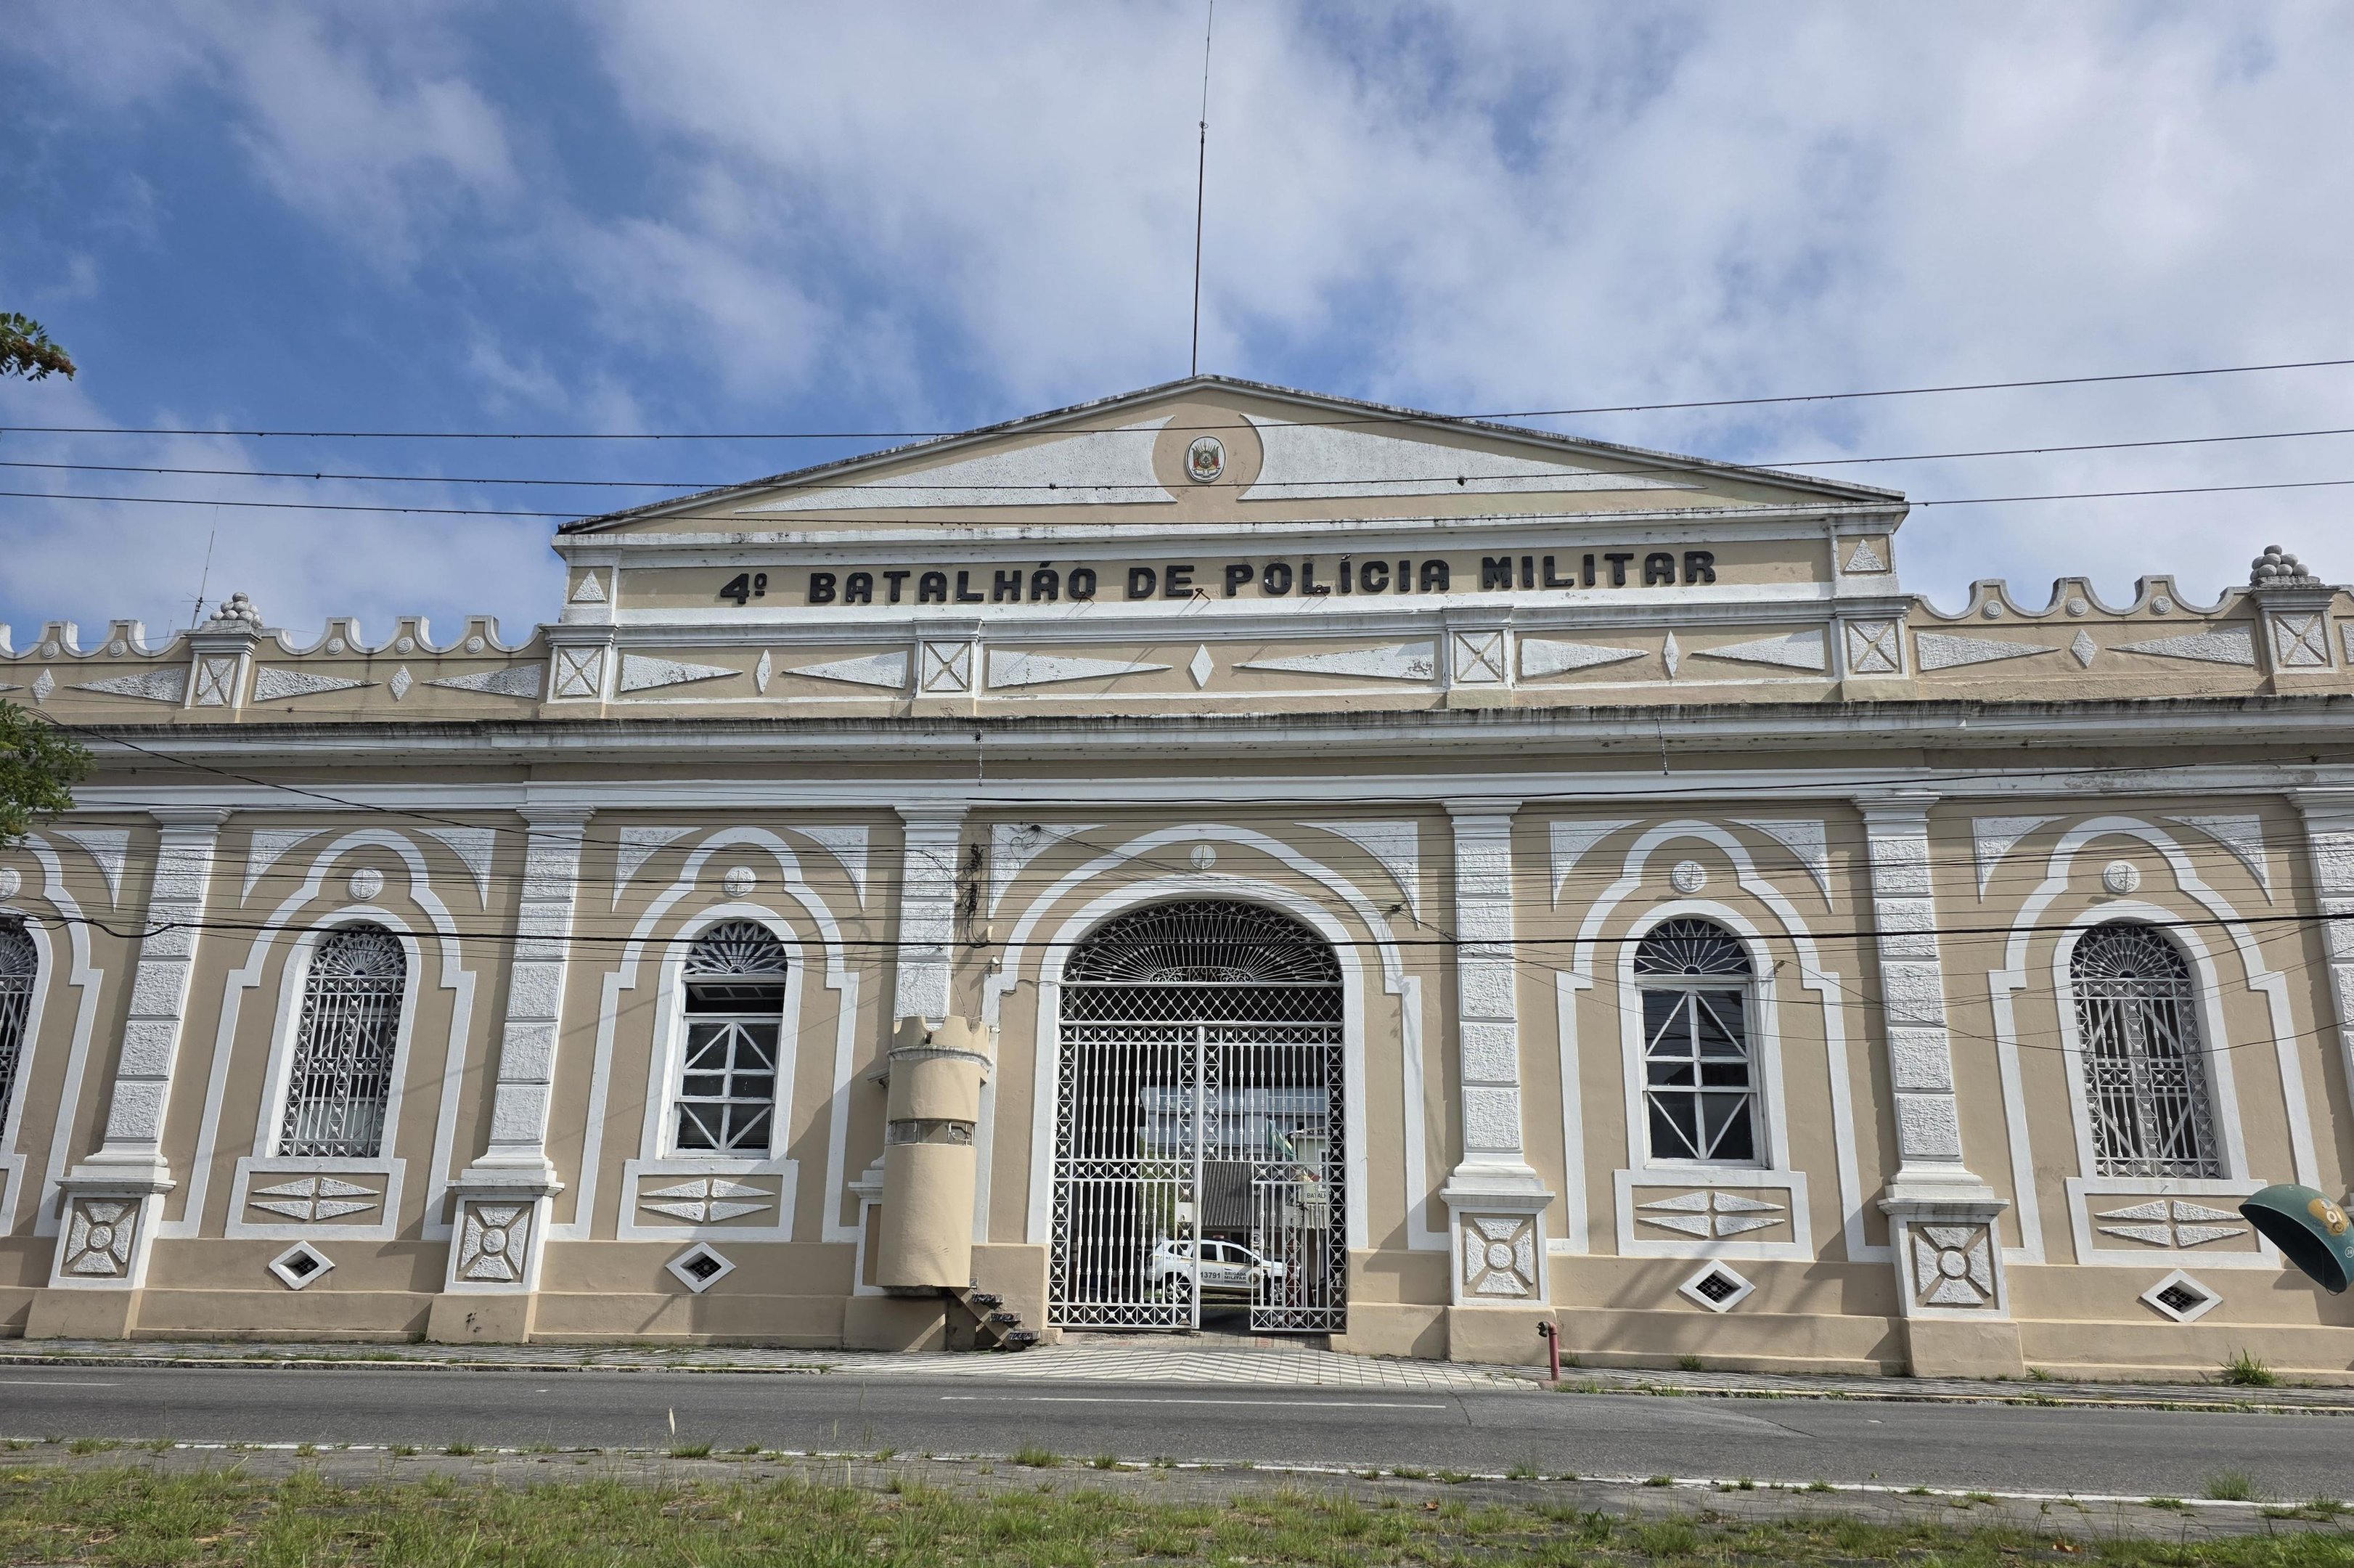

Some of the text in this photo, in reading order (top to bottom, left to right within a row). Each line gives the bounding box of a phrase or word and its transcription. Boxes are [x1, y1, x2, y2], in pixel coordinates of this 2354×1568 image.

[1128, 566, 1195, 599] DE
[1226, 553, 1450, 596] POLÍCIA
[1483, 550, 1717, 589] MILITAR
[1186, 967, 1217, 981] 1898
